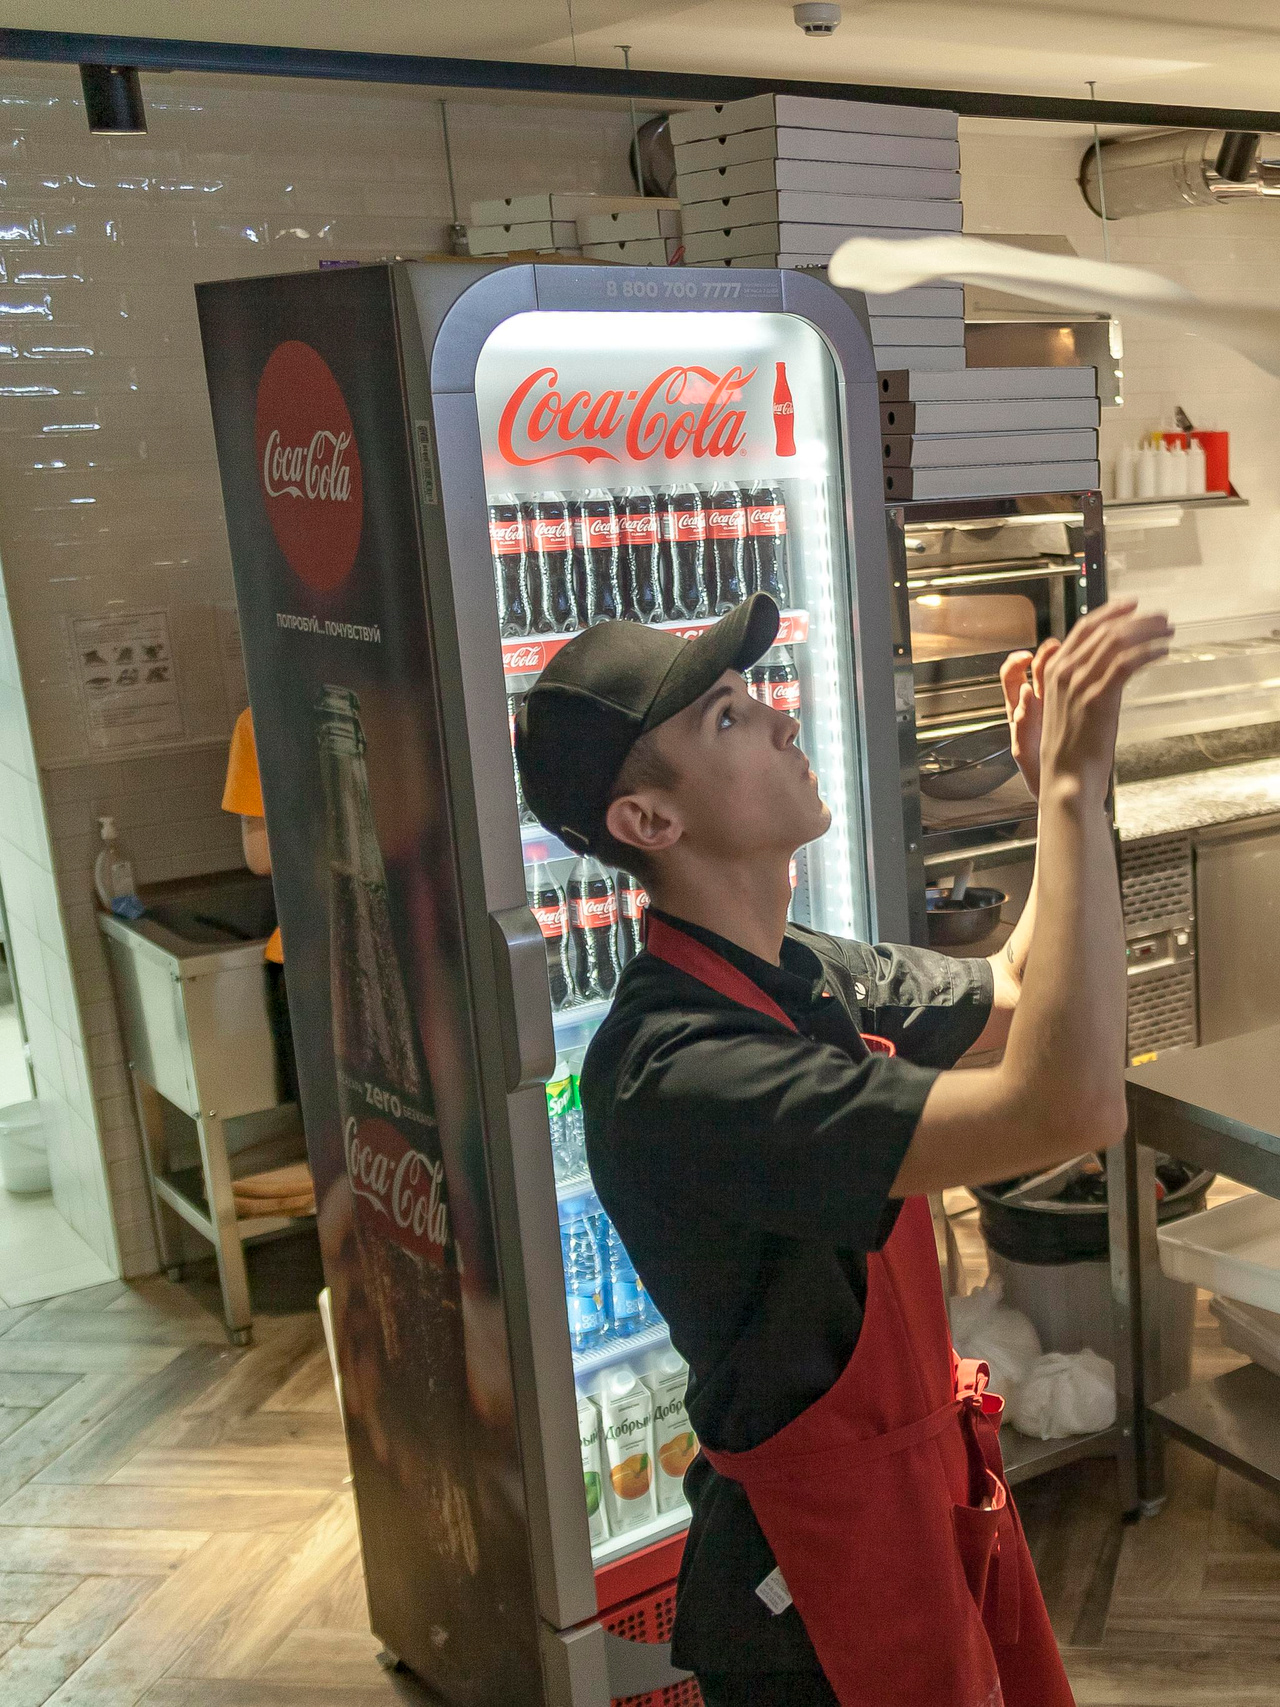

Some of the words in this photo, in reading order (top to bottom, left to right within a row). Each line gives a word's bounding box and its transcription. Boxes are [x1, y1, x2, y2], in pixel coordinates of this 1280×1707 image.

[606, 280, 617, 297] 8
[622, 280, 657, 297] 800
[663, 281, 697, 298] 700
[702, 282, 741, 298] 7777
[498, 365, 758, 467] Coca-Cola
[264, 429, 351, 501] Coca-Cola
[364, 1081, 402, 1118] zero
[344, 1116, 448, 1246] Coca-Cola
[653, 1398, 683, 1421] Добр
